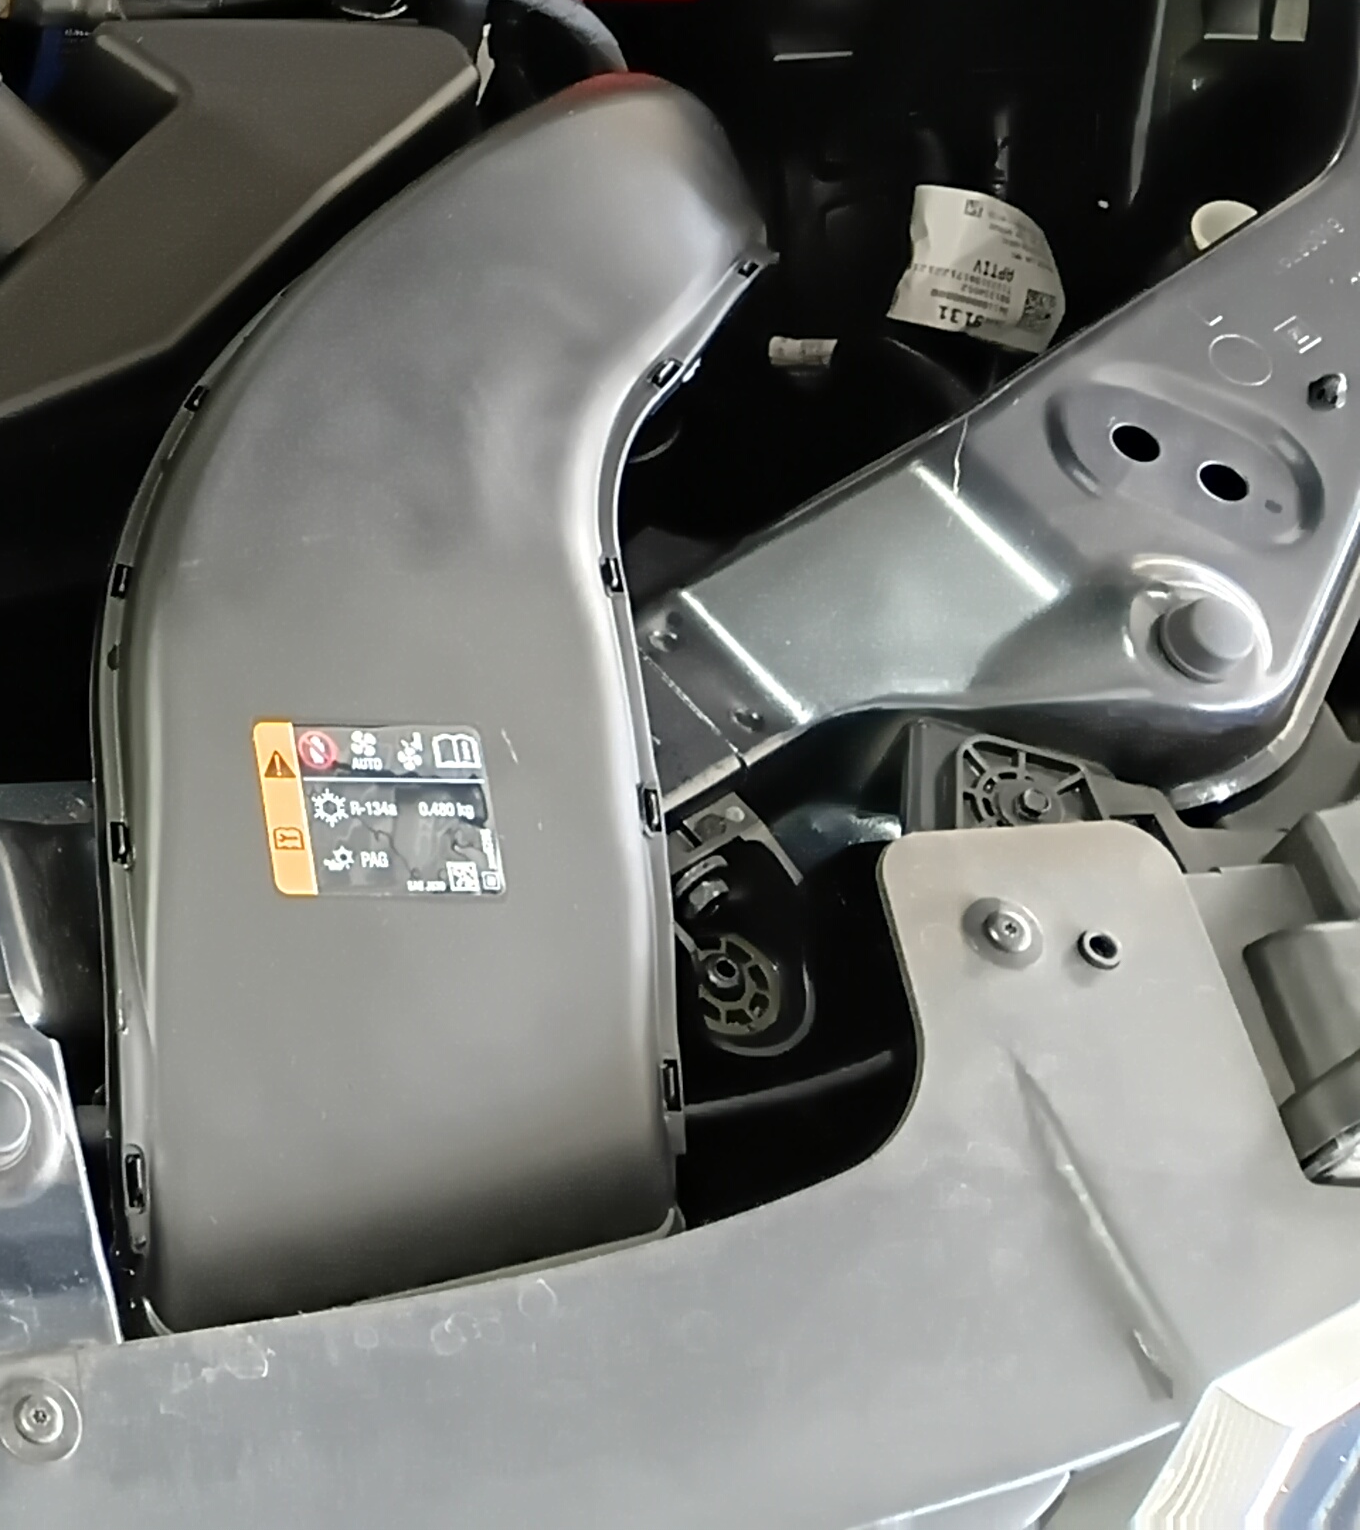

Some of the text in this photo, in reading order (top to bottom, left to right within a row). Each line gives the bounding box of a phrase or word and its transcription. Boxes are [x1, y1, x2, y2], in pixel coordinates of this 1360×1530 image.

[351, 757, 383, 771] AUTO
[349, 802, 398, 817] R-134a
[456, 802, 475, 820] kg
[360, 851, 389, 868] PAG
